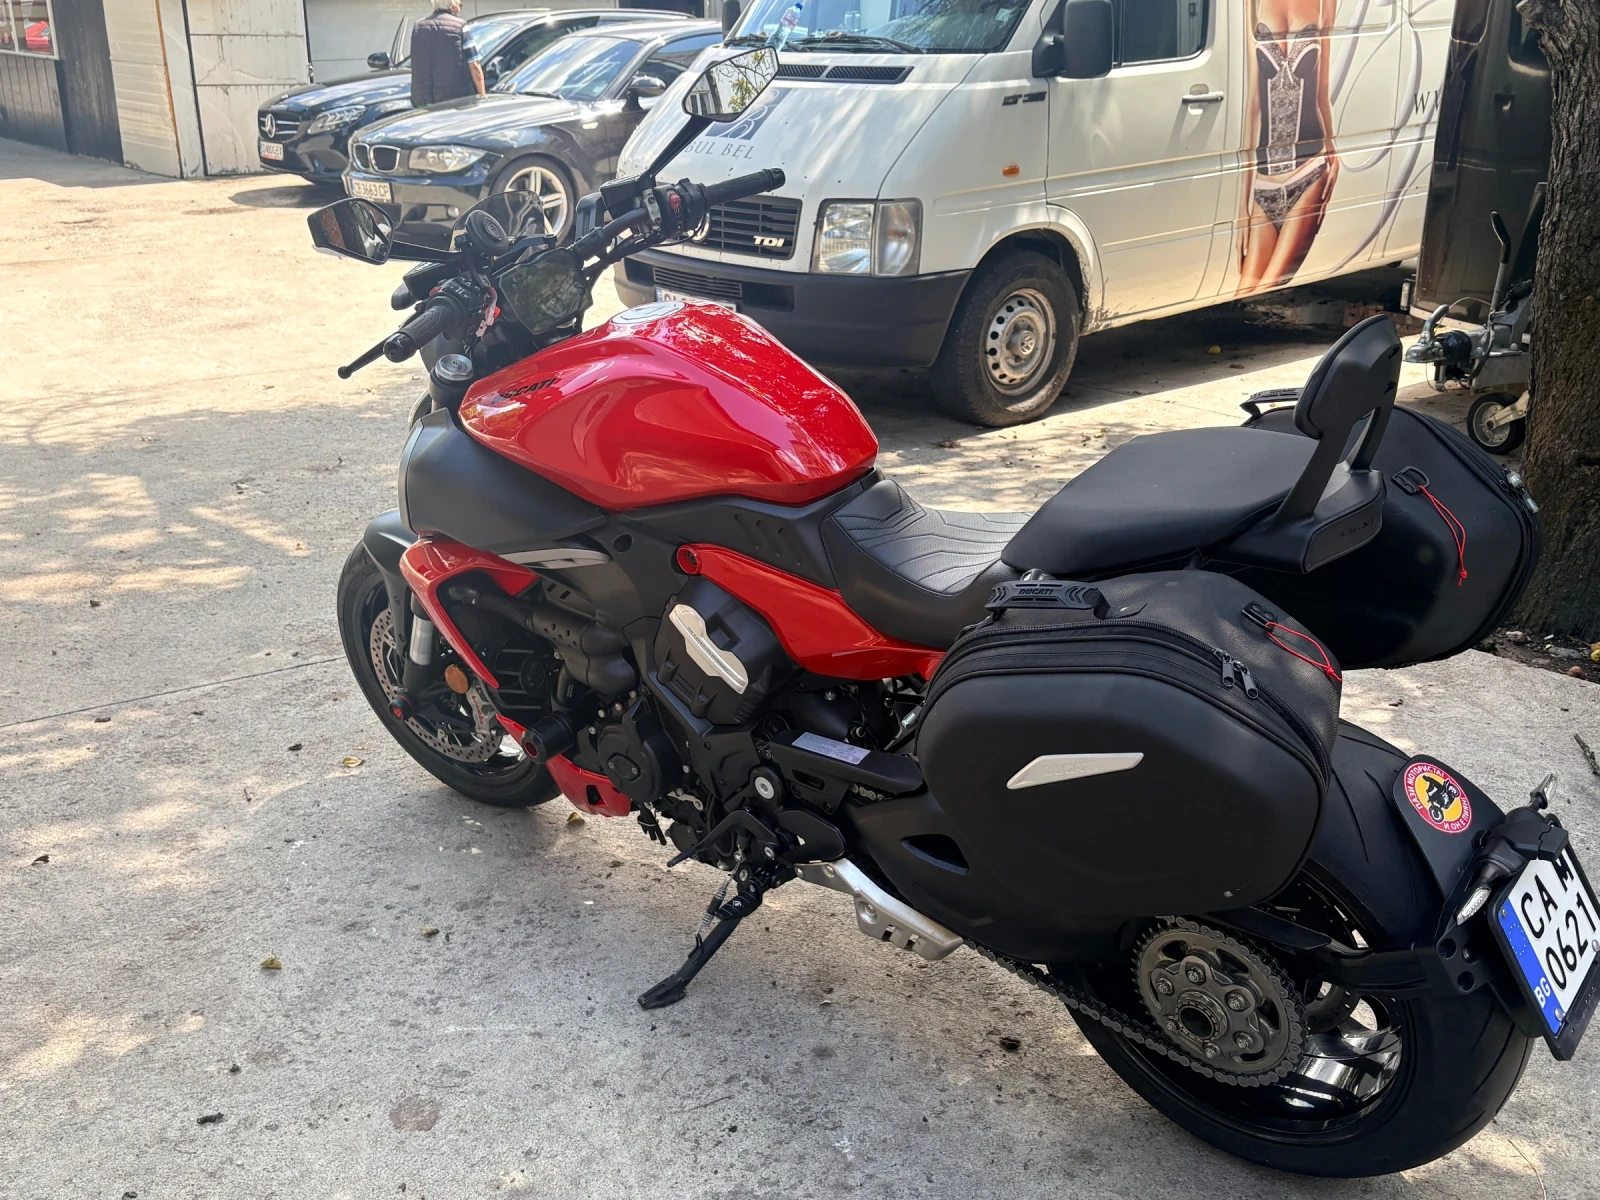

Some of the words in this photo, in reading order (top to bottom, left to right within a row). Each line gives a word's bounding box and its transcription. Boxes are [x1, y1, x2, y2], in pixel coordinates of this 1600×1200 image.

[684, 141, 716, 155] BUL
[721, 143, 755, 160] BEL
[753, 235, 785, 248] TDI
[1018, 588, 1054, 596] DUCATI
[1520, 873, 1559, 940] CA
[1545, 891, 1597, 991] 0621
[1533, 976, 1551, 1009] BG
